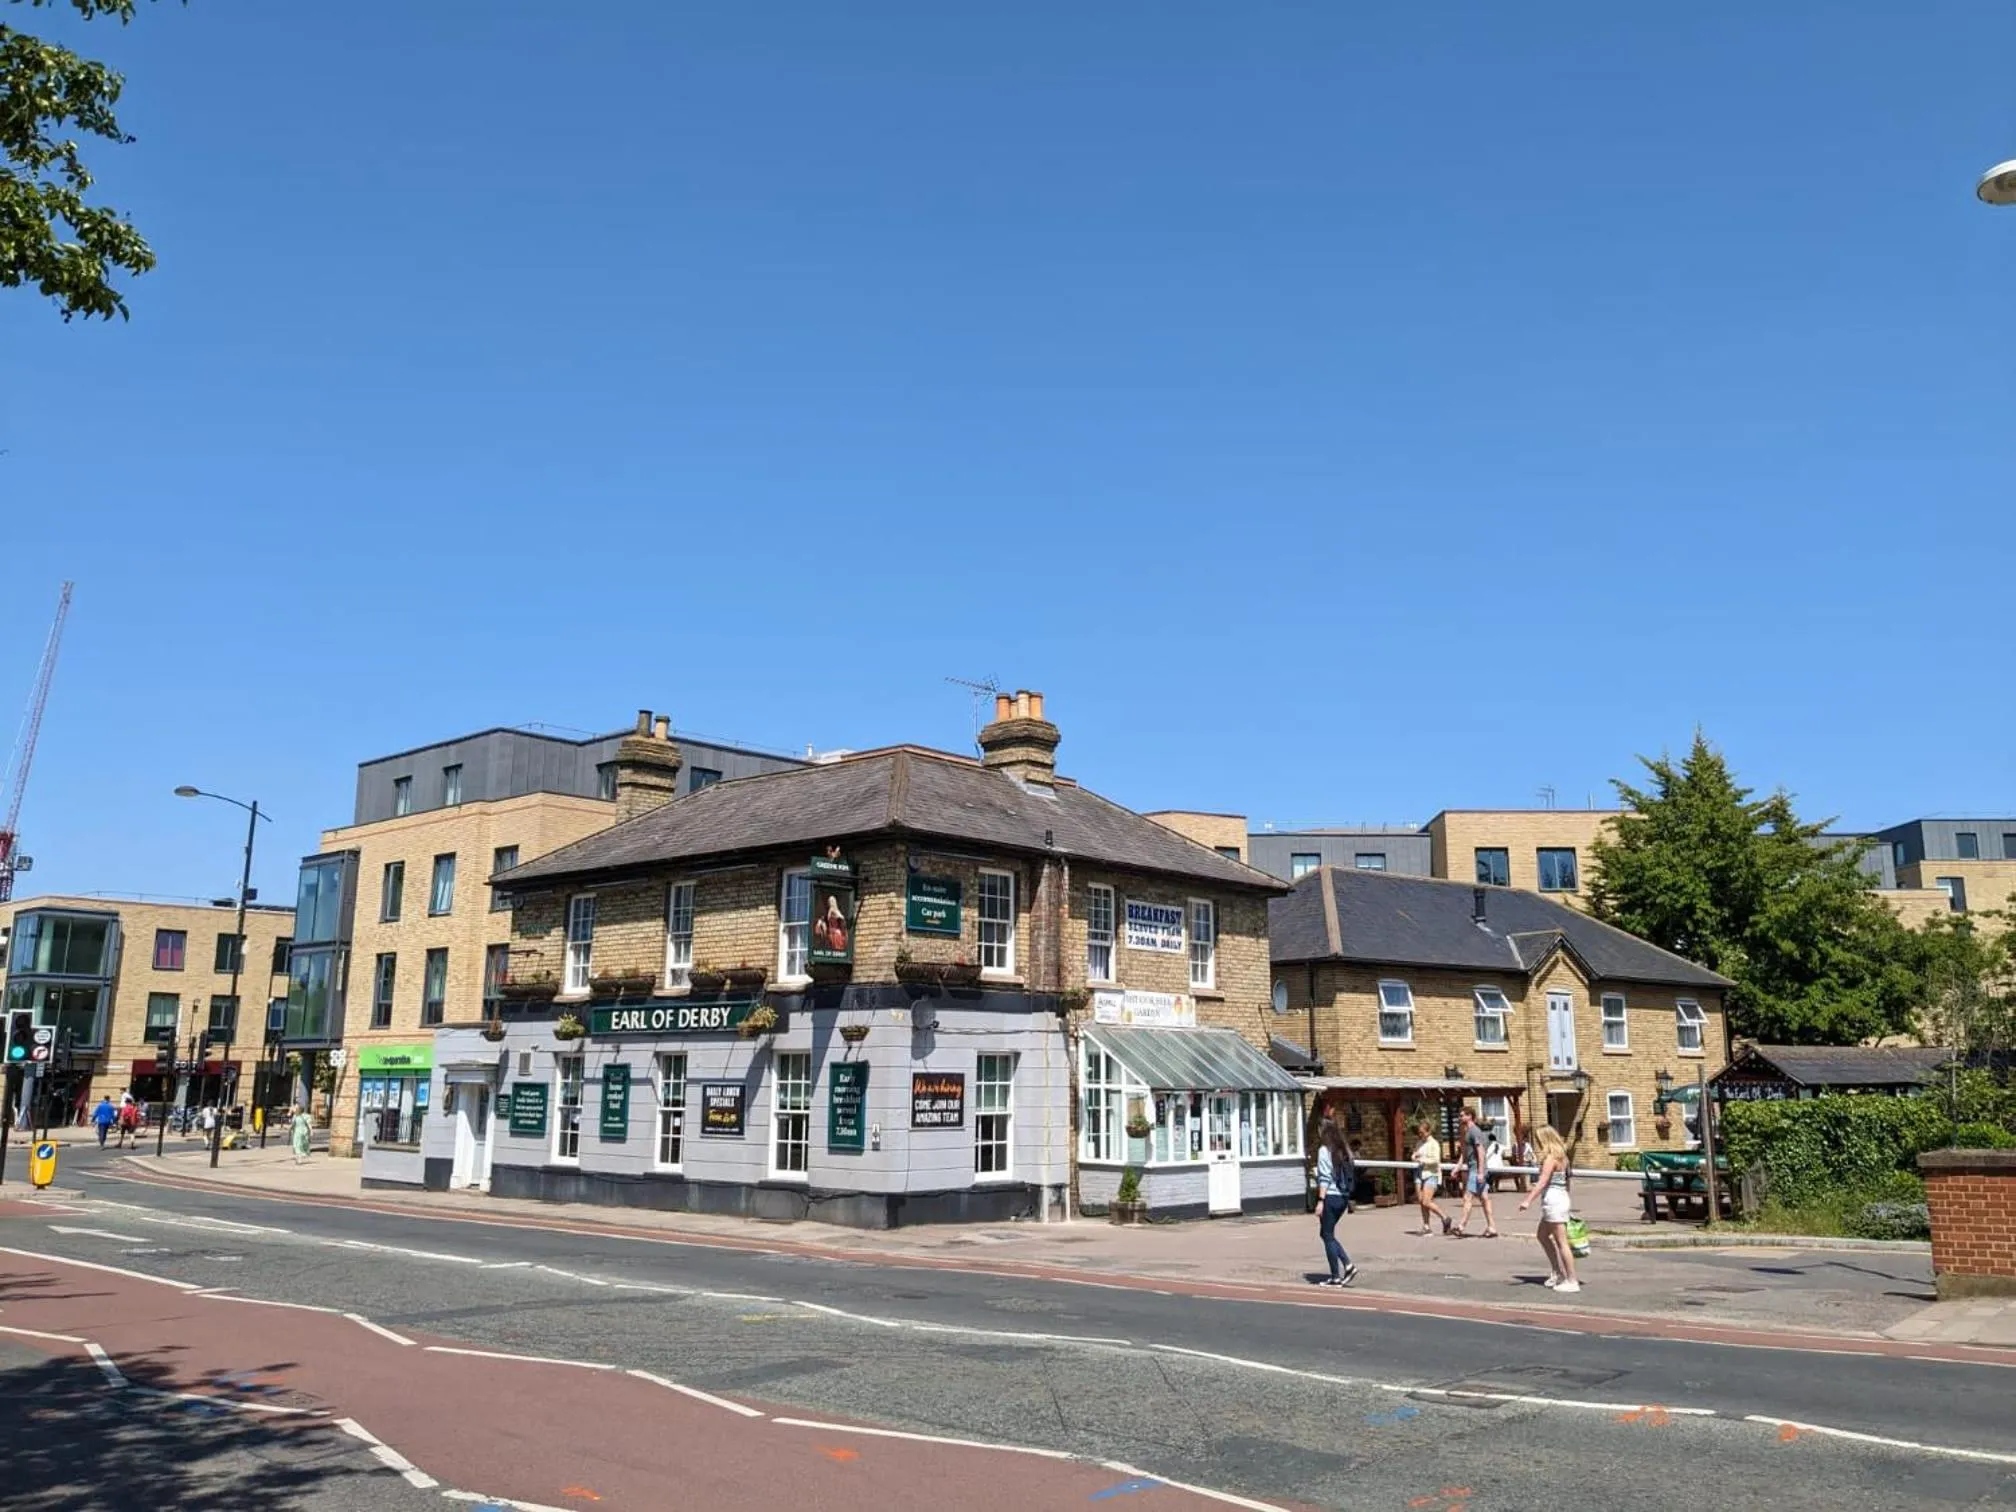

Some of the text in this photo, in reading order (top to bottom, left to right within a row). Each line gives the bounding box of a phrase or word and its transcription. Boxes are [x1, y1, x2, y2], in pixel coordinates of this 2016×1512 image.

[921, 907, 932, 916] Car
[1127, 903, 1182, 925] BREAKFAST
[1160, 938, 1182, 950] DAILY
[611, 1007, 732, 1030] EARL OF DERBY
[915, 1100, 931, 1110] COME
[947, 1100, 960, 1110] OUR
[915, 1112, 959, 1123] AMAZING TEAM
